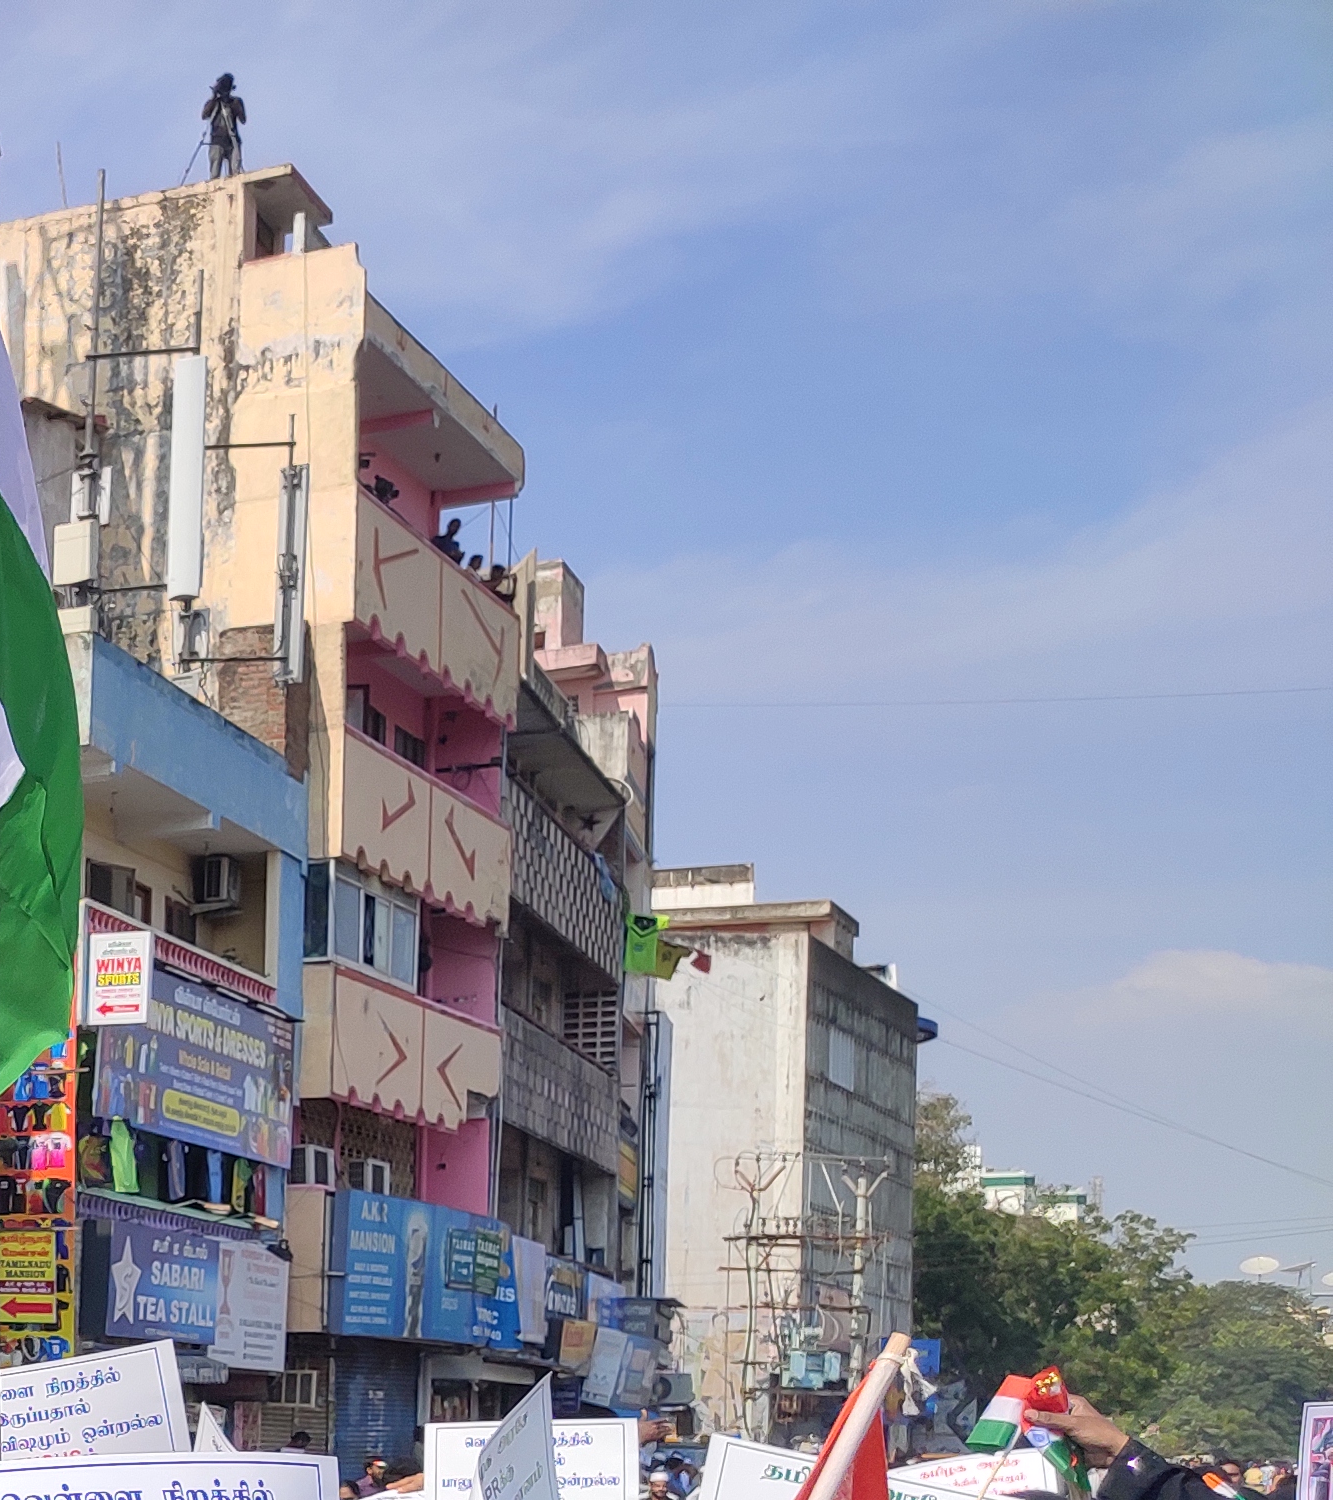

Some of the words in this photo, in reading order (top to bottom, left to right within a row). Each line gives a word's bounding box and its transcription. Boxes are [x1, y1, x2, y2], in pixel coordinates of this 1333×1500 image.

[96, 957, 142, 974] WINYA
[97, 972, 140, 986] SPORTS
[176, 1006, 215, 1051] SPORTS
[350, 1230, 396, 1254] MANSION
[5, 1270, 46, 1278] MANSION
[151, 1261, 206, 1291] SABARI
[136, 1296, 167, 1322] TEA
[170, 1299, 213, 1327] STALL
[44, 1365, 122, 1401] நிறத்தில்
[81, 1411, 164, 1445] ஒன்றல்ல
